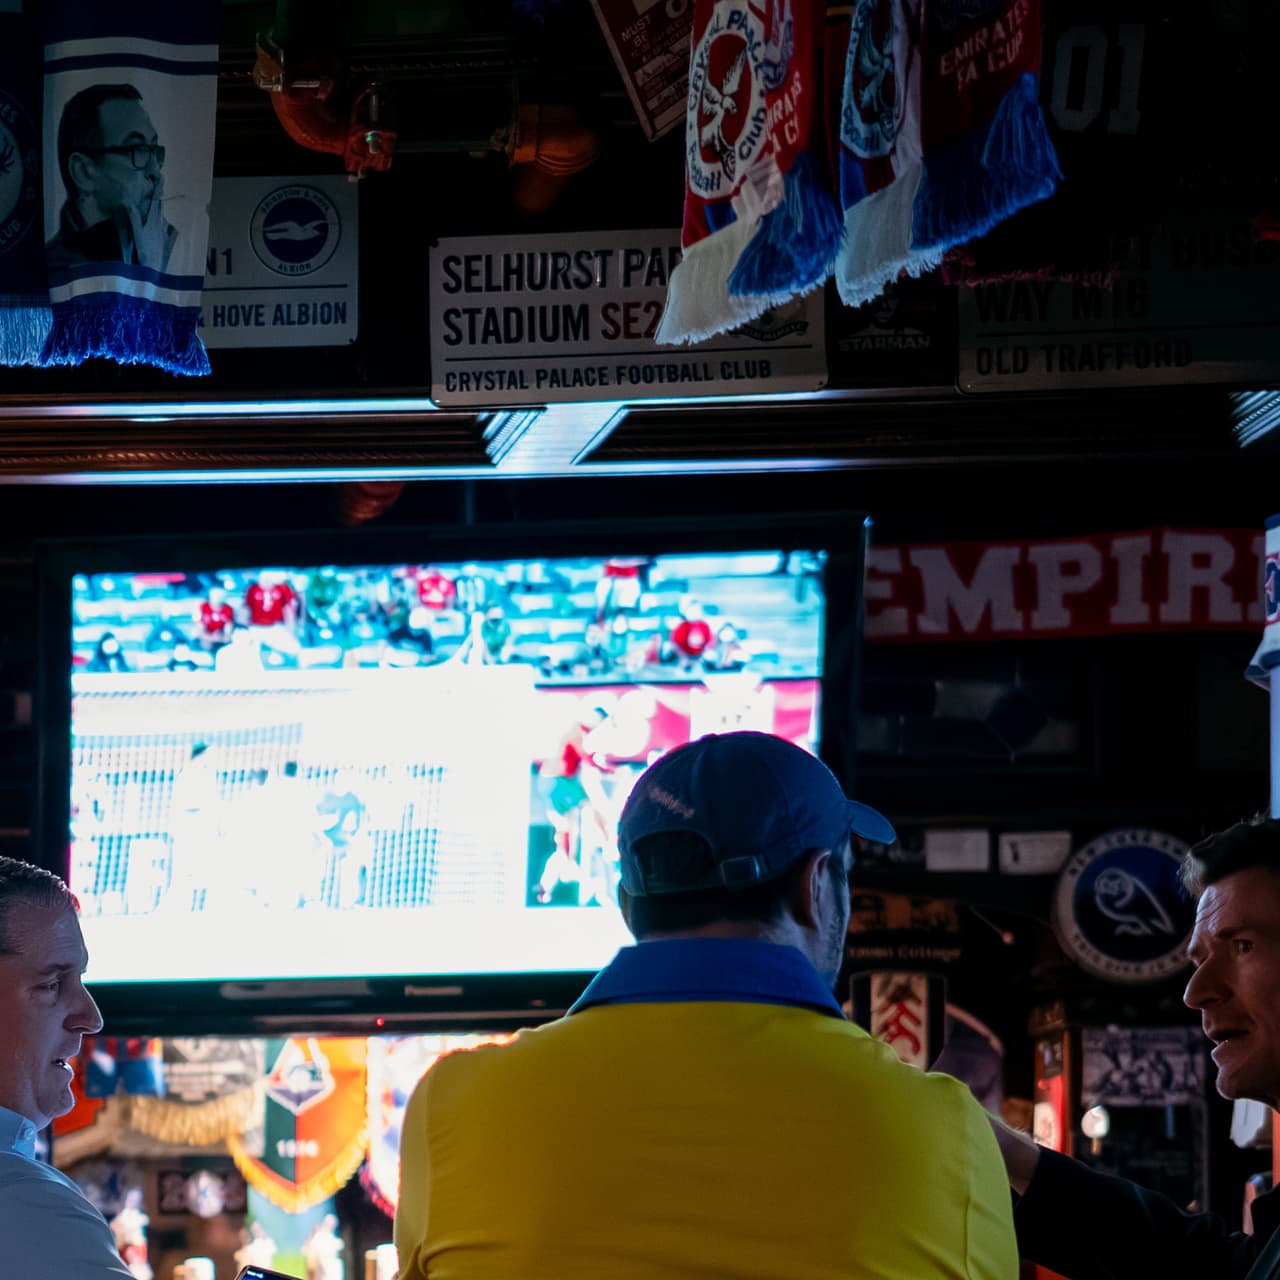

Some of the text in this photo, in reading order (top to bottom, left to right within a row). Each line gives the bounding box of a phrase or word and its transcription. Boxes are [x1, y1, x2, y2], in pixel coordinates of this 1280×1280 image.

[1049, 23, 1147, 136] 01
[442, 250, 613, 293] SELHURST
[214, 302, 347, 328] HOVE ALBION
[975, 286, 1054, 323] WAY
[443, 304, 590, 346] STADIUM
[839, 334, 932, 353] STARMAN
[976, 339, 1193, 375] OLD TRAFFORD
[445, 360, 771, 392] CRYSTAL PALACE FOOTBALL CLUB
[864, 530, 1267, 637] EMPIR
